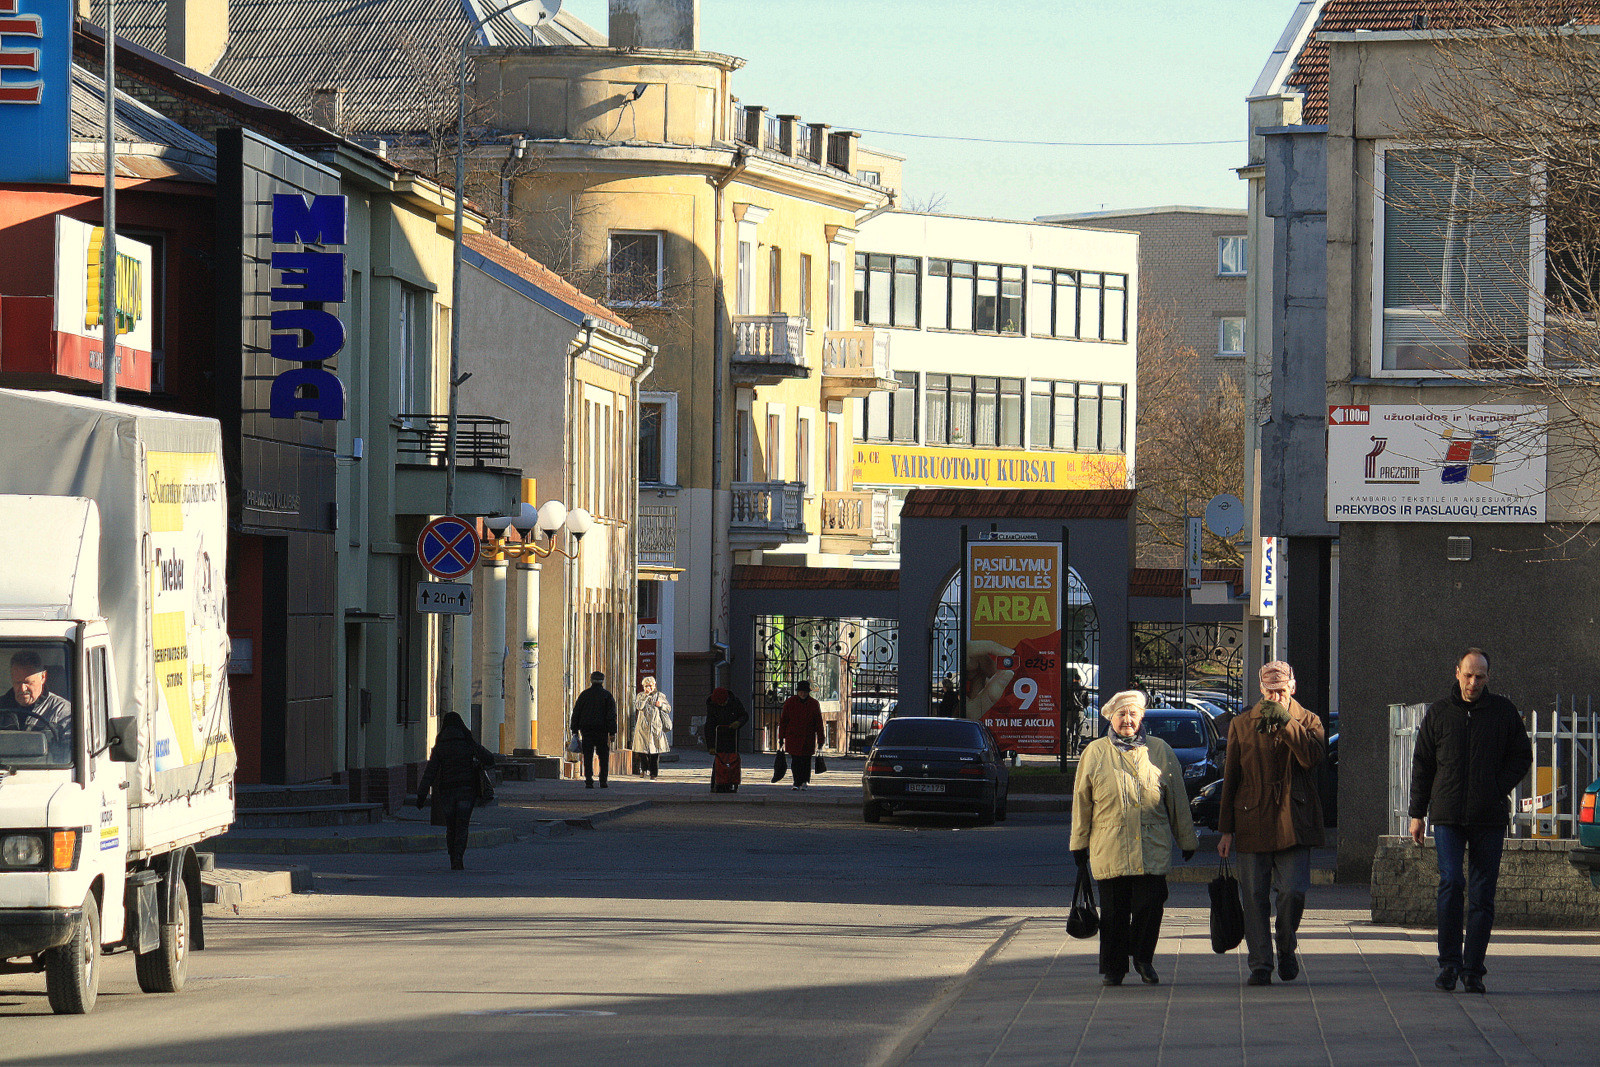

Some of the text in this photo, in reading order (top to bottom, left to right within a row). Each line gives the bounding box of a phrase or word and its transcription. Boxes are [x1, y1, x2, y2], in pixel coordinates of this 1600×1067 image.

[1383, 412, 1448, 422] užuolaidos
[1452, 413, 1461, 422] ir
[891, 454, 991, 487] VAIRUOTOJŲ
[996, 458, 1056, 483] KURSAI
[1335, 504, 1538, 518] PREKYBOS IR PASLAUGŲ CENTRAS
[973, 555, 1052, 575] PASIŪLYMŲ
[973, 571, 1052, 589] DŽIUNGLĖS
[973, 595, 1052, 622] ARBA
[1013, 677, 1038, 710] 9
[984, 718, 1055, 727] IR TAI NE AKCIJA
